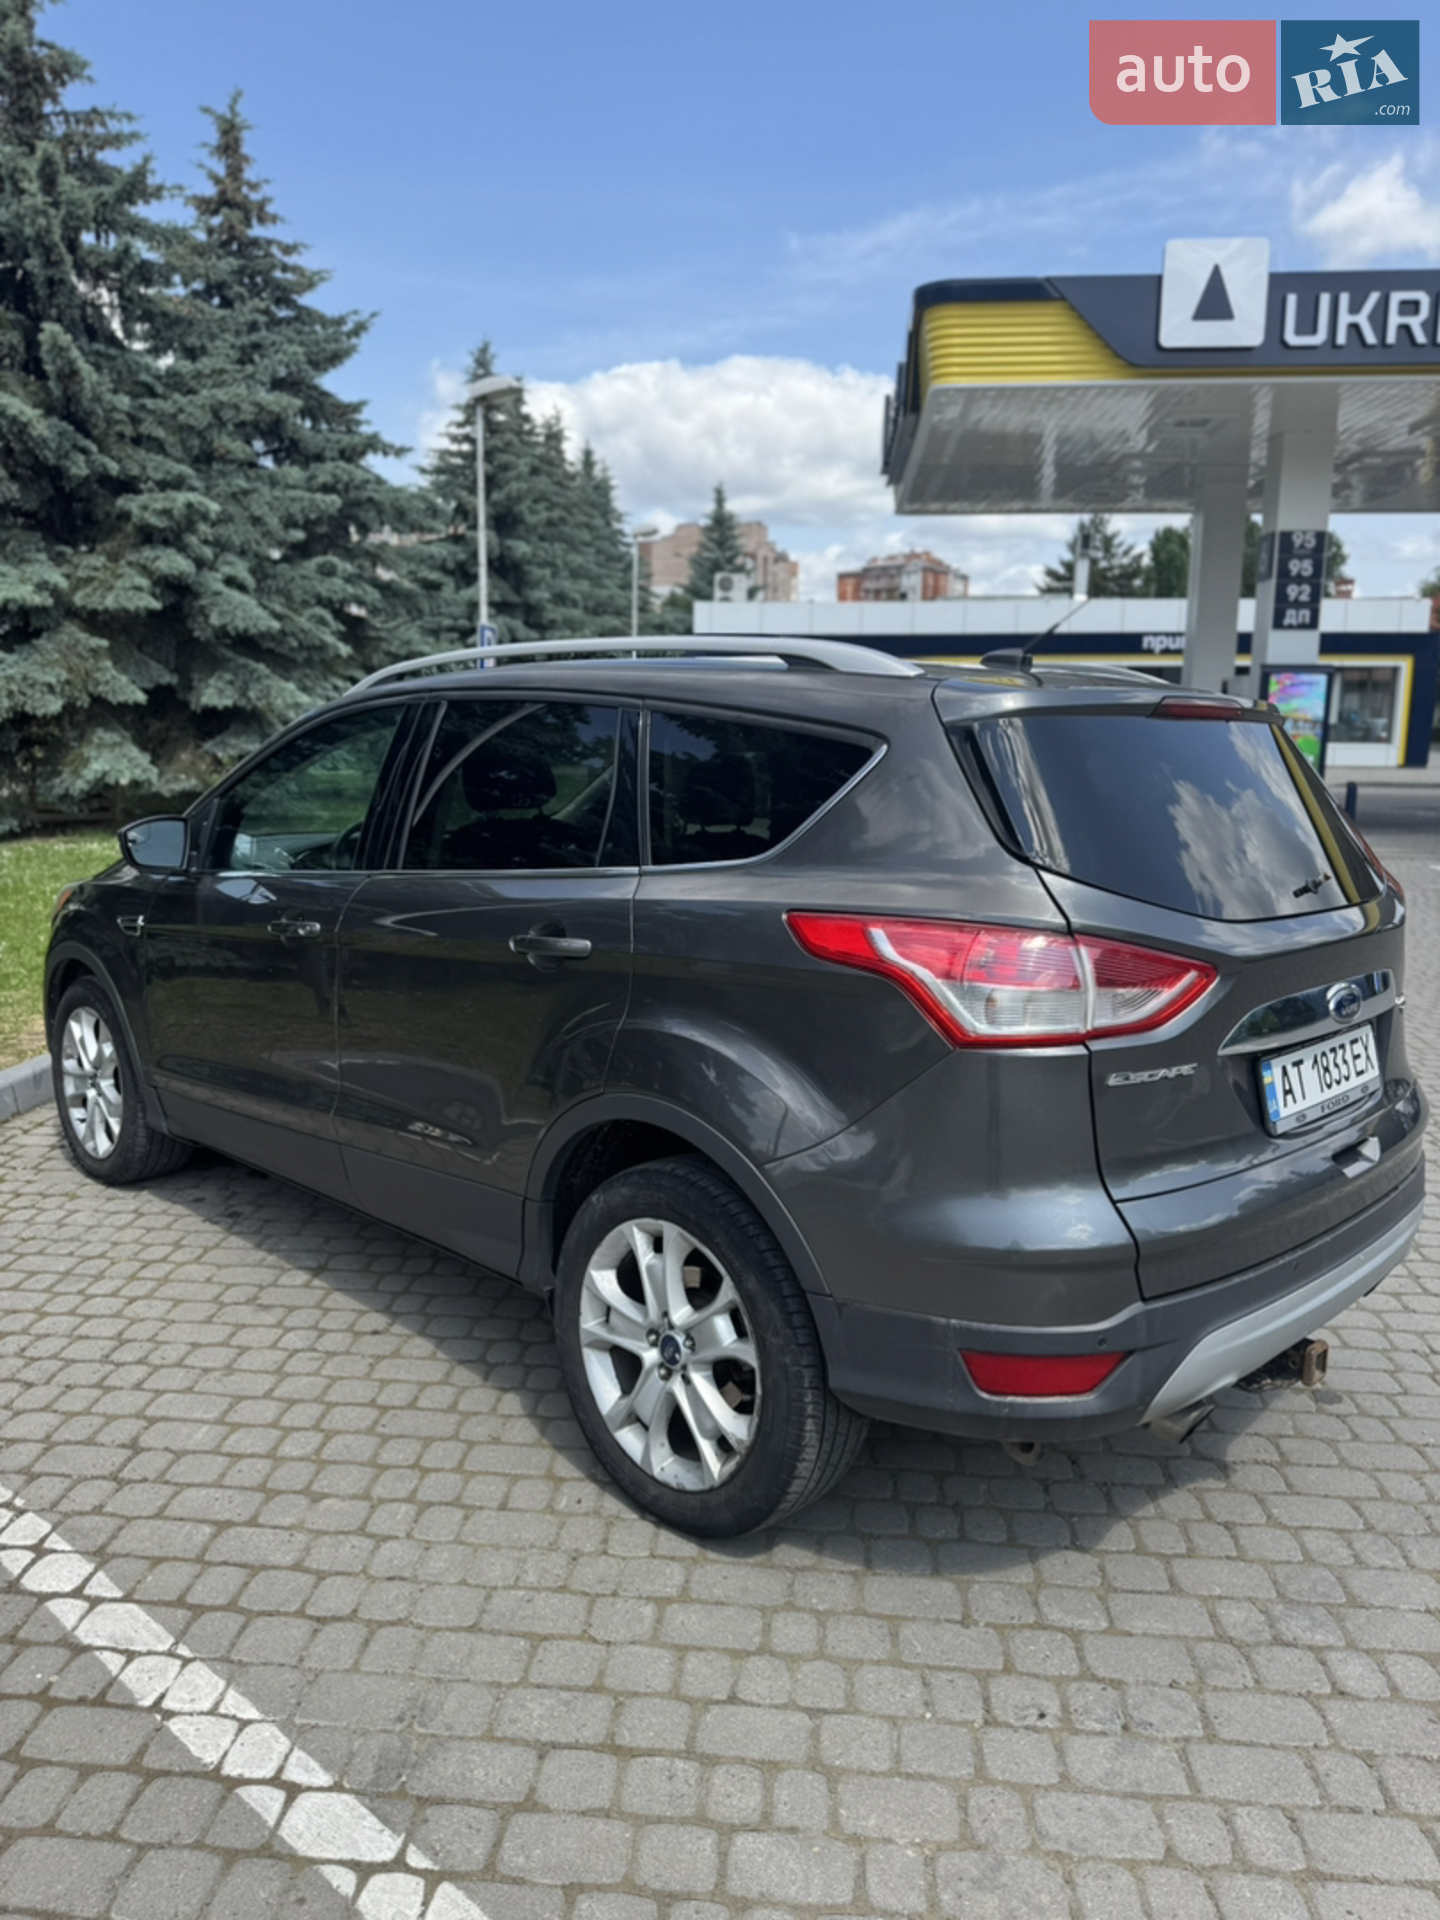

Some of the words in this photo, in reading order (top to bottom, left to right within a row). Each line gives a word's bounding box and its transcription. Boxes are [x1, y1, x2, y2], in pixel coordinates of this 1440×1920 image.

[1283, 290, 1440, 346] UKR
[1291, 531, 1316, 549] 95
[1288, 558, 1314, 577] 95
[1286, 583, 1311, 602] 92
[1281, 1058, 1306, 1108] AT
[1311, 1043, 1351, 1093] 1833
[1349, 1033, 1375, 1077] EX
